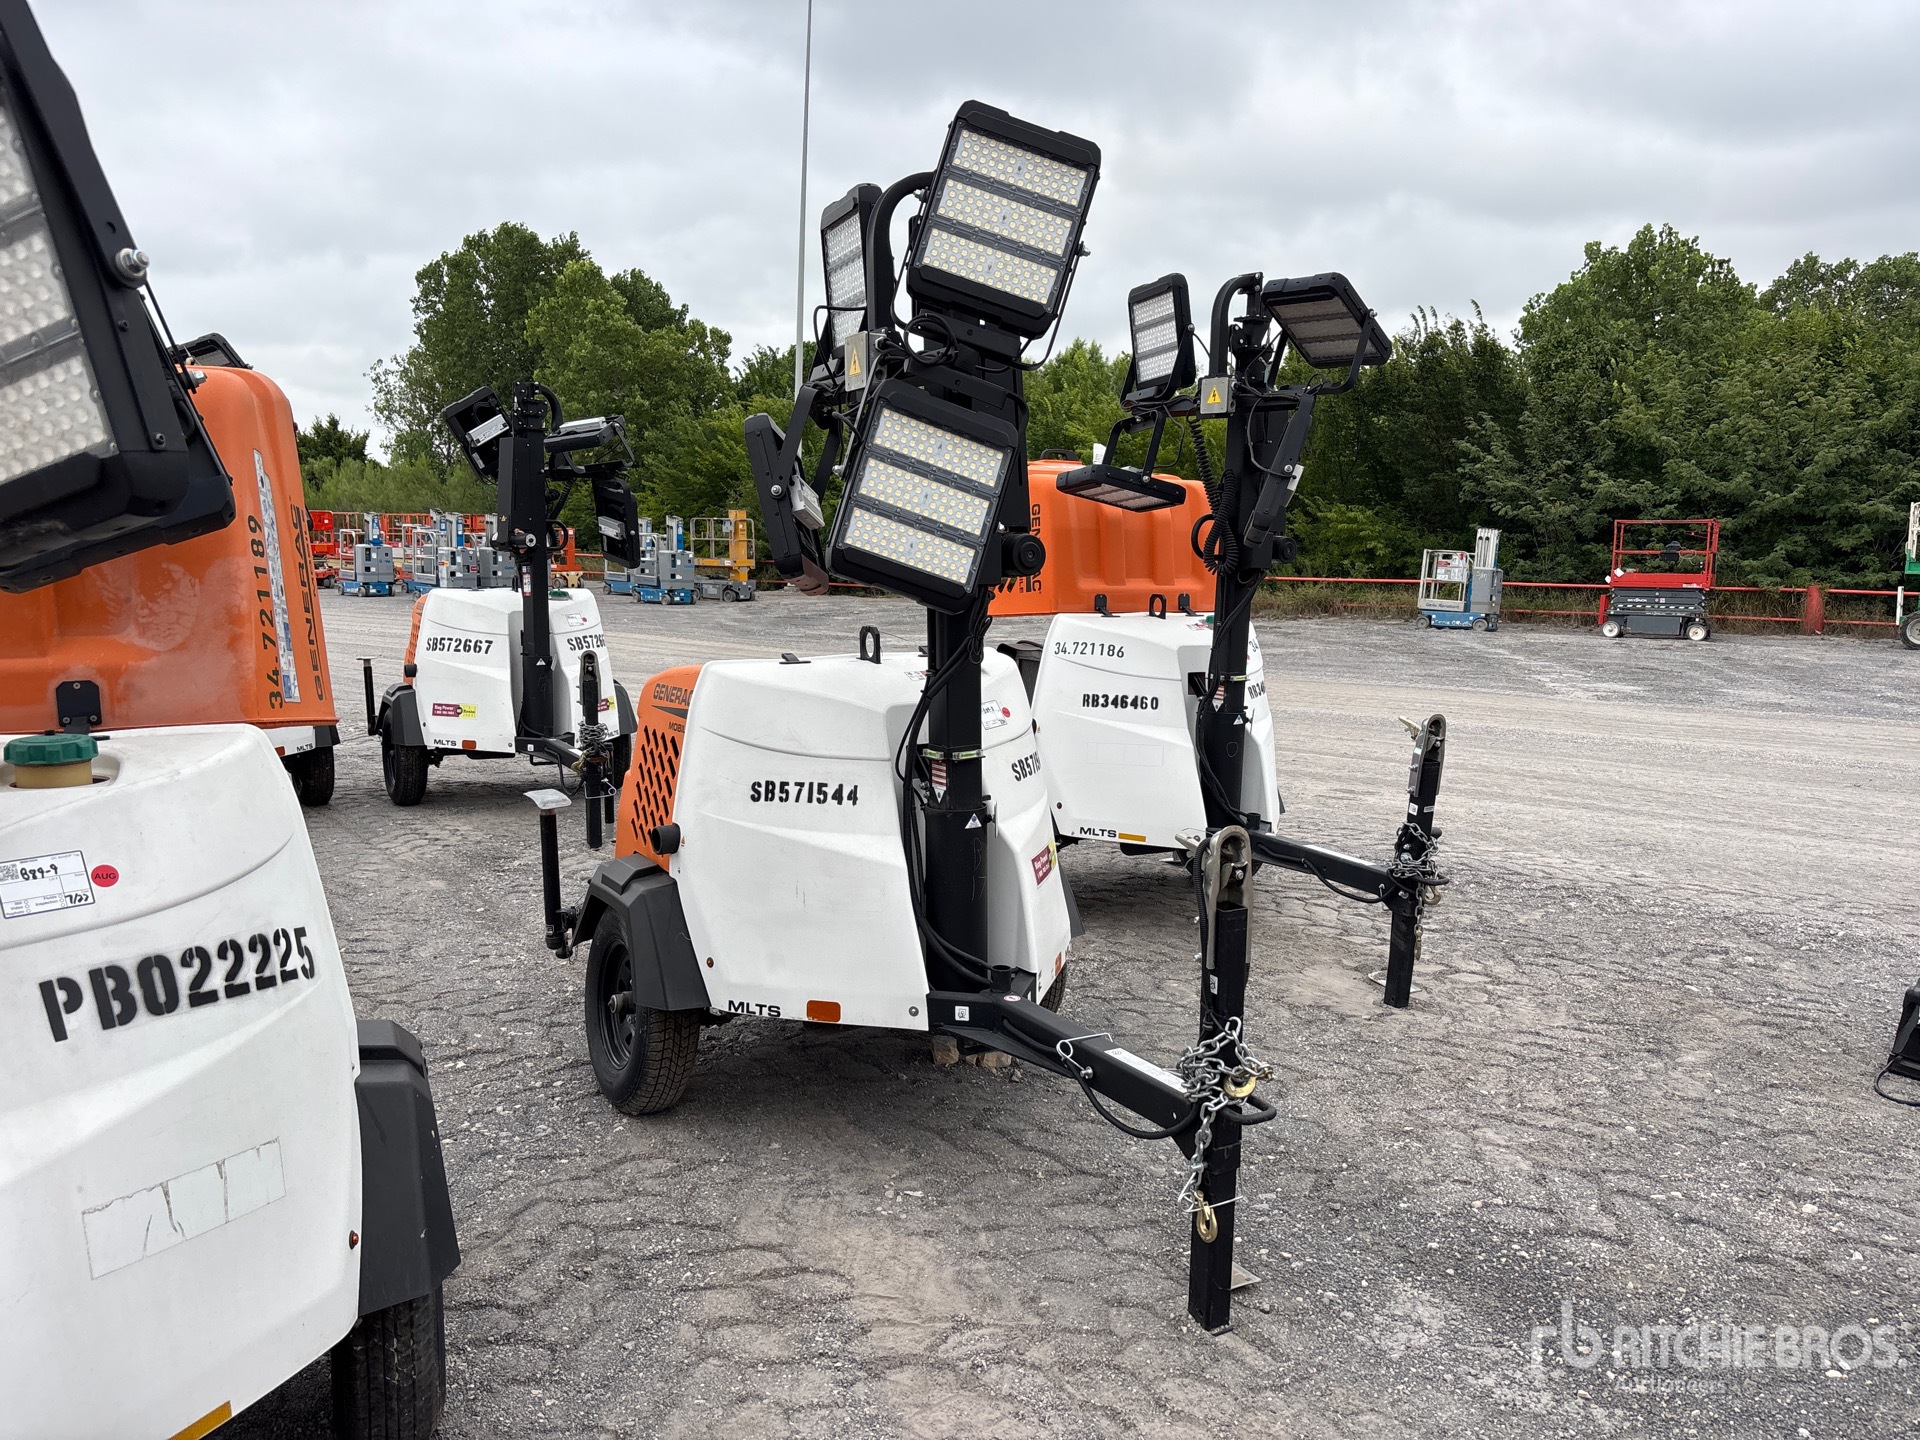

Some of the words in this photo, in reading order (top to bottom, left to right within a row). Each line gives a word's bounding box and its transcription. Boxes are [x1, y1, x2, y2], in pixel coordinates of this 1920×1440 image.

[289, 503, 324, 700] GENERAC
[425, 636, 494, 655] SB572667
[1054, 641, 1125, 658] 34.721186
[1082, 693, 1159, 711] RB346460
[296, 742, 314, 752] MLTS
[434, 738, 457, 748] MLTS
[750, 780, 859, 807] SB571544
[1079, 826, 1117, 839] MLTS
[39, 926, 315, 1042] PB022225
[727, 999, 781, 1017] MLTS
